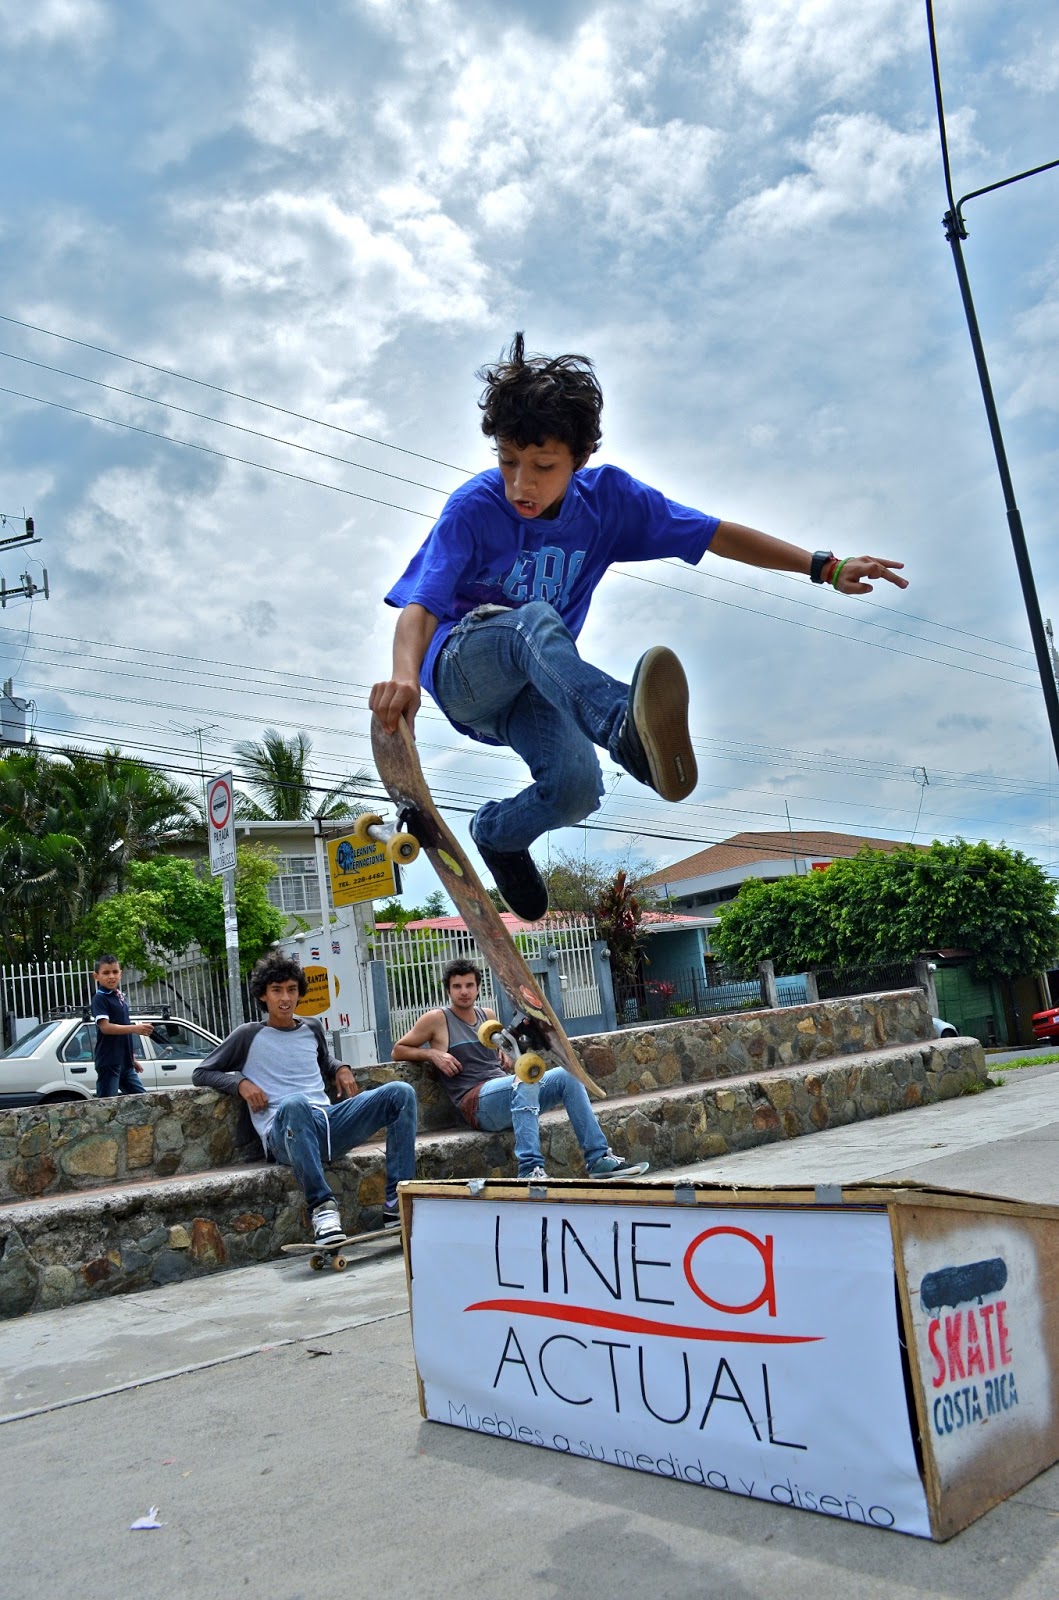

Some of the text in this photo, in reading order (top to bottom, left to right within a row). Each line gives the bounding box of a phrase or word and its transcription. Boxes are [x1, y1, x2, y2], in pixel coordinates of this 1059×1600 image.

[213, 827, 230, 843] PARADA
[219, 842, 225, 855] DE
[307, 972, 328, 984] RANTIA
[928, 1300, 1013, 1389] SKATE
[493, 1326, 808, 1451] ACTUAL
[933, 1372, 1019, 1437] COSTA RICA
[448, 1400, 895, 1528] Muebles a su medida y diseño
